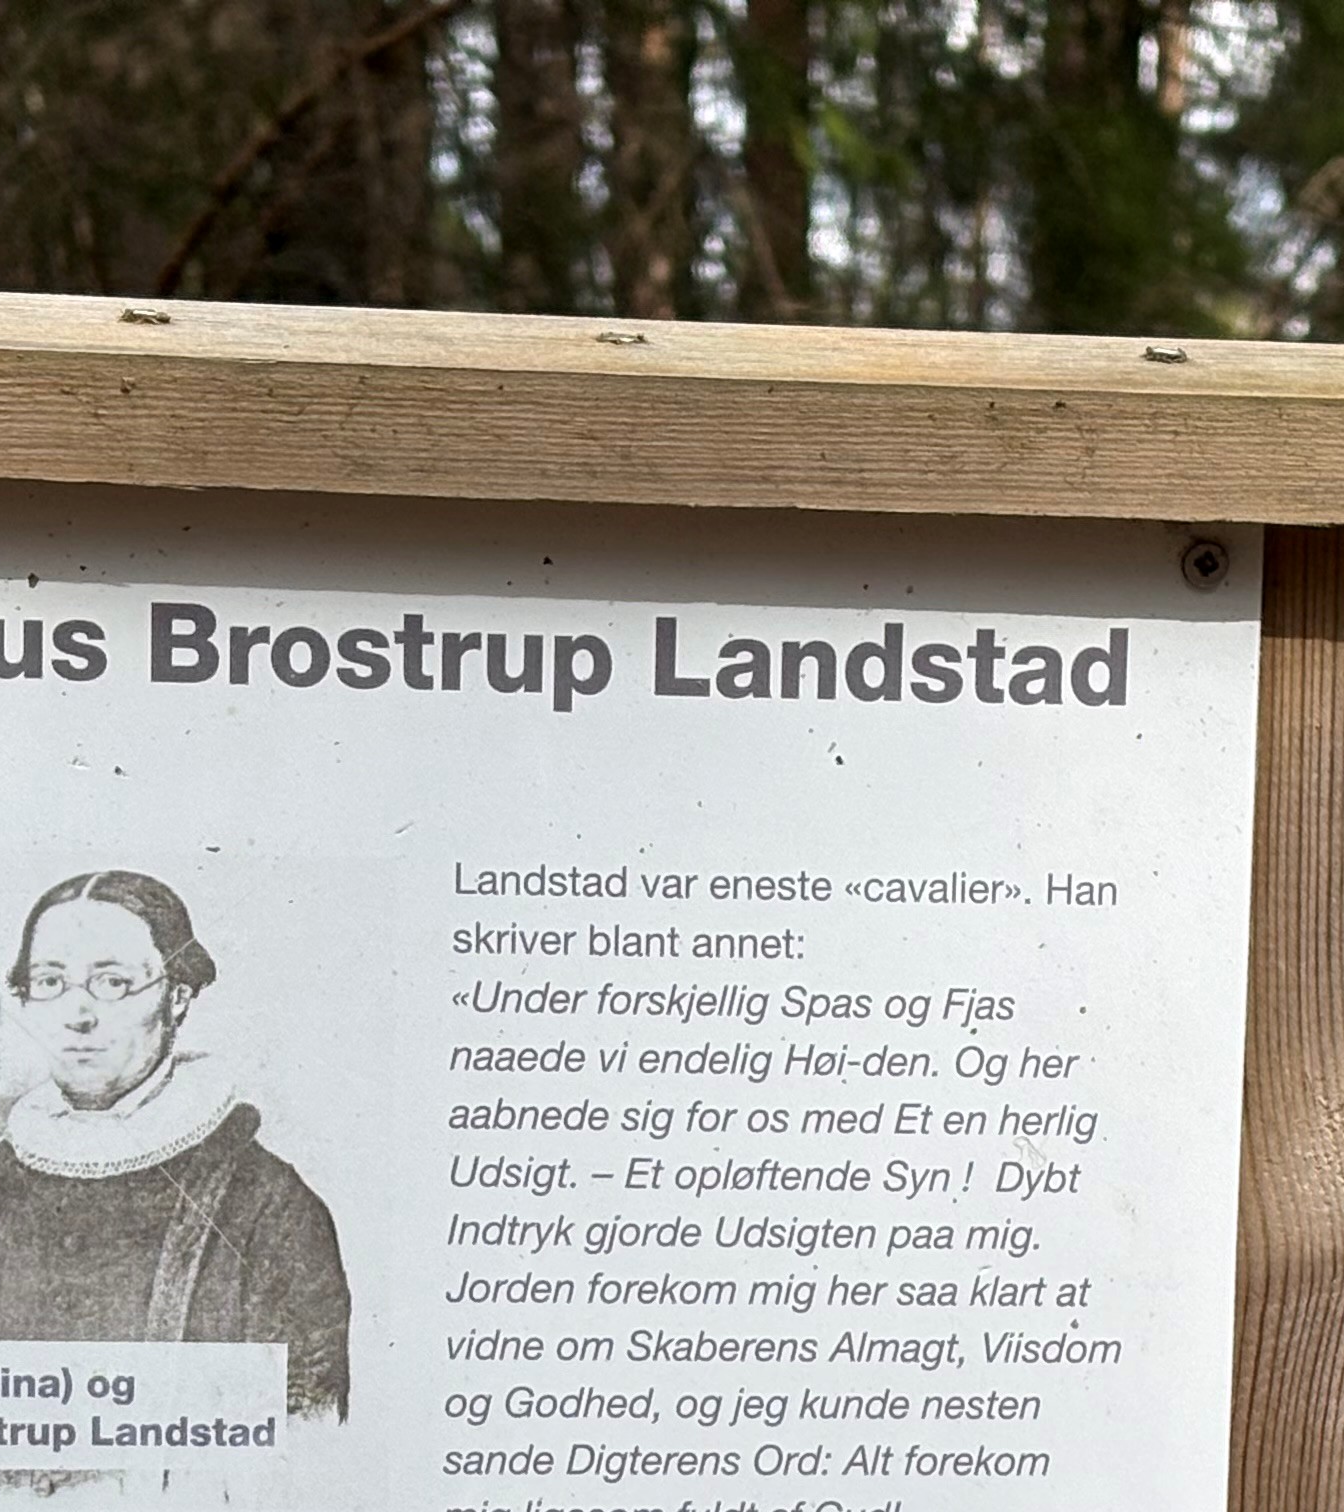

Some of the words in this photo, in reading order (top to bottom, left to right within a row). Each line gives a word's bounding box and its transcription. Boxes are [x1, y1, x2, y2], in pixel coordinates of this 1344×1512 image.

[150, 602, 613, 714] Brostrup
[653, 616, 1129, 708] Landstad
[455, 861, 628, 898] Landstad
[640, 873, 699, 900] var
[709, 870, 833, 902] eneste
[844, 871, 1032, 905] «cavalier».
[1046, 872, 1118, 907] Han
[452, 920, 578, 956] skriver
[588, 923, 681, 958] blant
[691, 928, 805, 960] annet:
[451, 979, 589, 1015] «Under
[596, 982, 770, 1026] forskjellig
[780, 984, 873, 1027] Spas
[884, 994, 932, 1028] og
[942, 987, 1016, 1029] Fjas
[448, 1096, 610, 1132] aabnede
[620, 1099, 675, 1141] sig
[685, 1099, 739, 1133] for
[746, 1108, 790, 1134] os
[800, 1102, 885, 1135] med
[893, 1102, 934, 1136] Et
[943, 1110, 987, 1136] en
[997, 1103, 1098, 1145] herlig
[447, 1213, 576, 1255] Indtryk
[583, 1214, 702, 1256] gjorde
[715, 1215, 877, 1257] Udsigten
[885, 1225, 955, 1258] paa
[965, 1217, 1040, 1259] mig.
[447, 1327, 545, 1362] vidne
[556, 1336, 615, 1362] om
[626, 1329, 819, 1363] Skaberens
[827, 1330, 965, 1372] Almagt,
[983, 1329, 1122, 1365] Viisdom
[86, 1374, 136, 1406] og
[91, 1415, 276, 1448] Landstad
[442, 1443, 555, 1476] sande
[565, 1443, 742, 1484] Digterens
[753, 1443, 833, 1477] Ord:
[841, 1444, 895, 1477] Alt
[904, 1444, 1051, 1477] forekom
